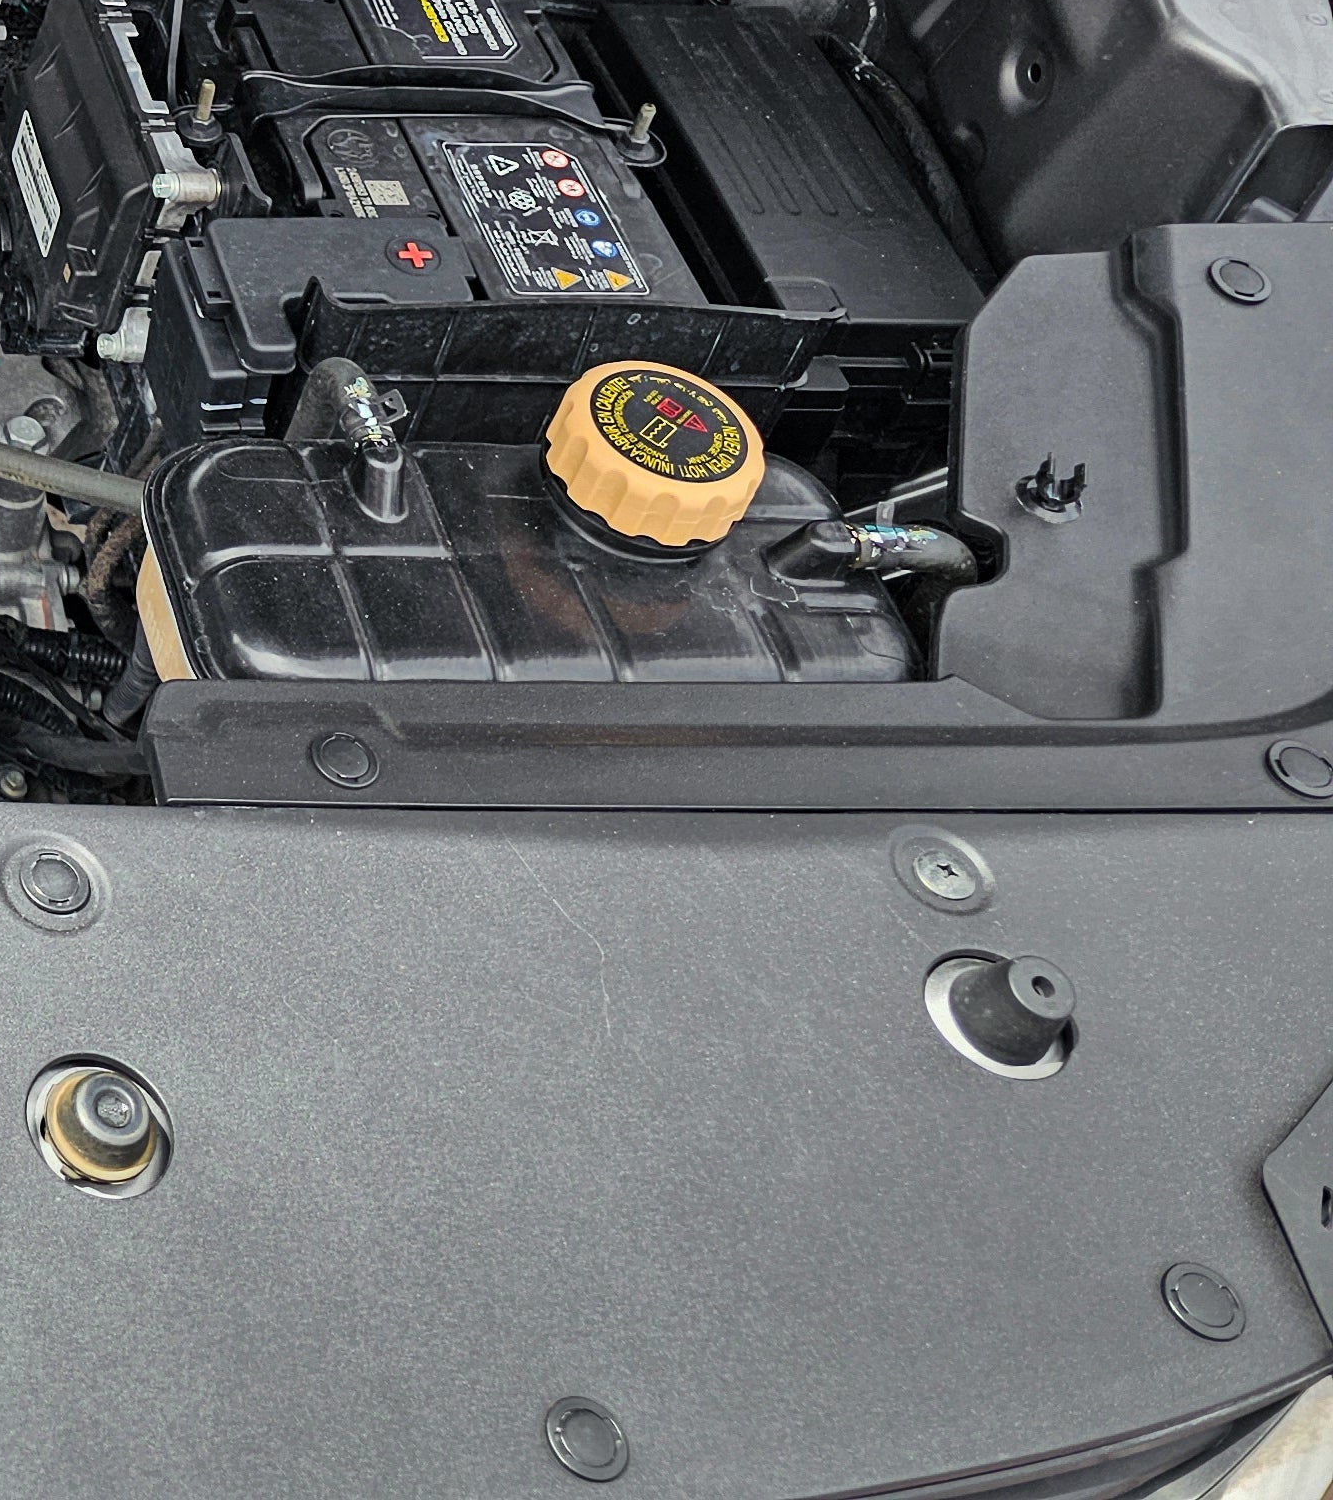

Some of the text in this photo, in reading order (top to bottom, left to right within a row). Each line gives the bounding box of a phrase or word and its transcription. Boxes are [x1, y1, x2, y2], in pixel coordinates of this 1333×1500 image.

[597, 410, 614, 424] EN
[603, 425, 633, 450] ABRIR
[722, 426, 741, 456] NEVER
[636, 442, 669, 462] TANQUE
[686, 433, 723, 465] SURGE TANK
[707, 454, 735, 474] OPEN
